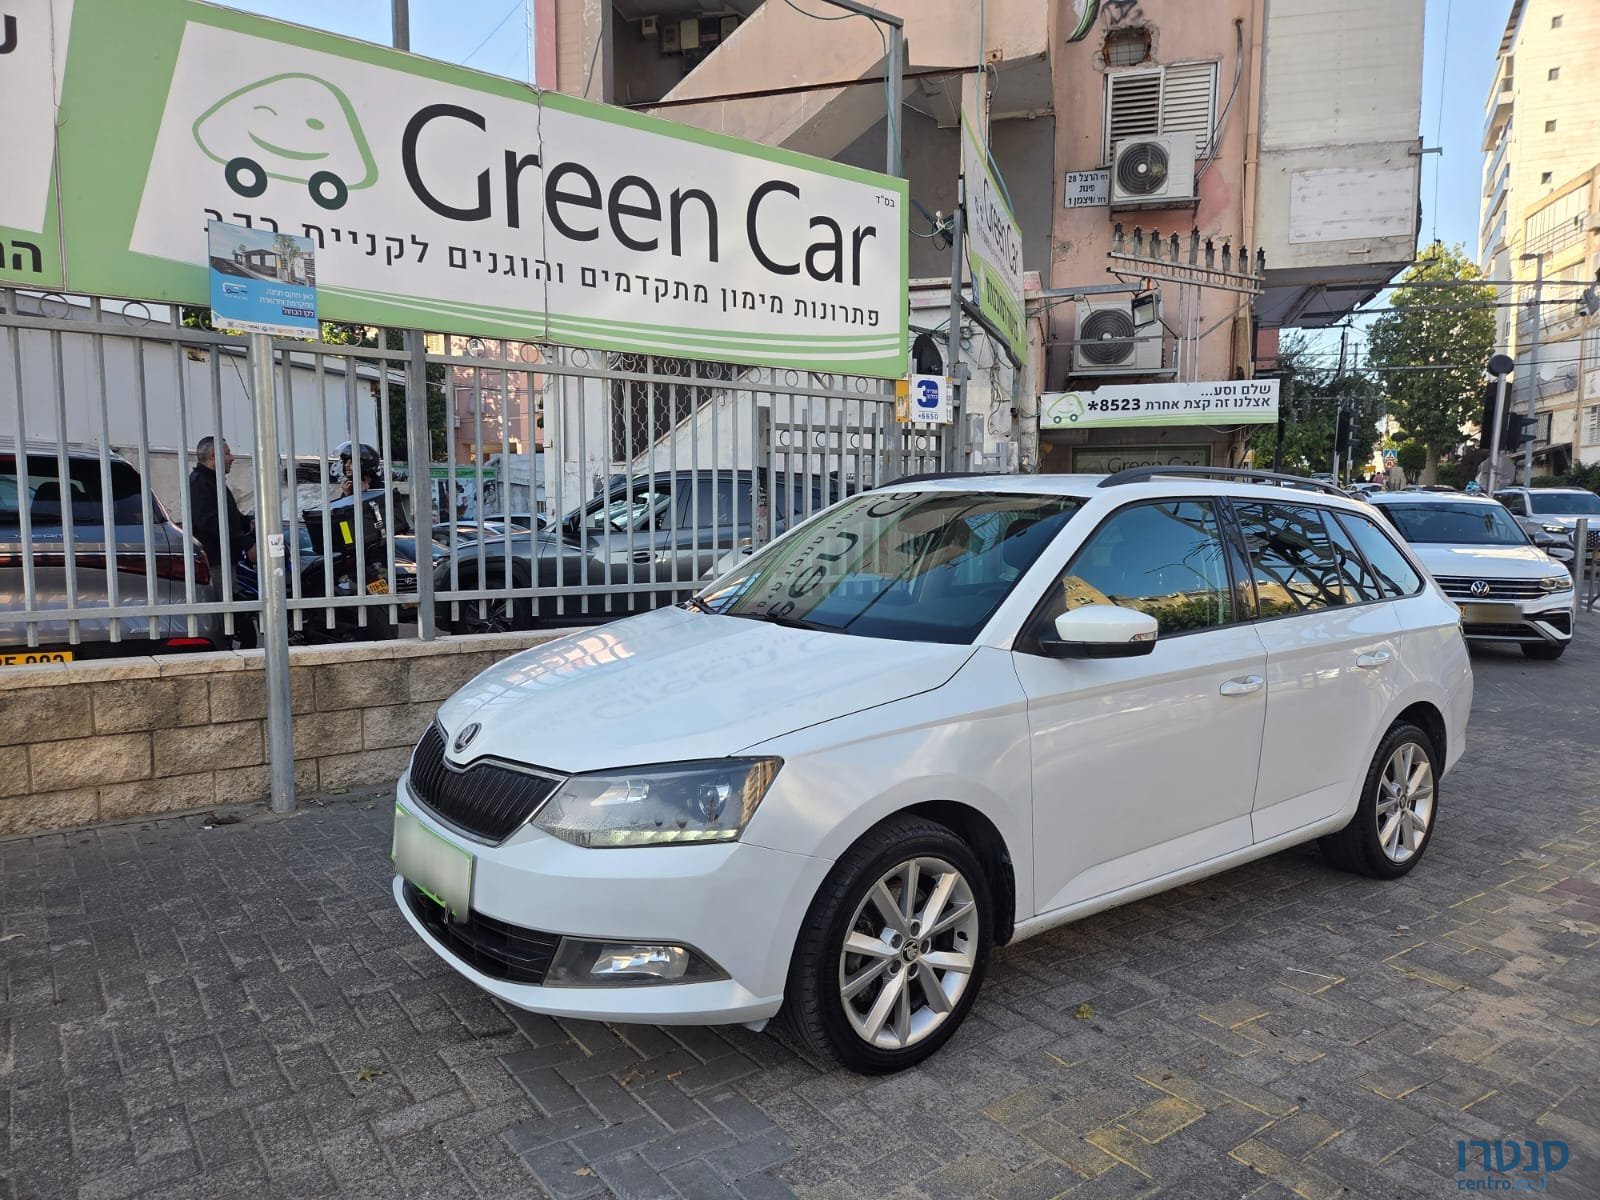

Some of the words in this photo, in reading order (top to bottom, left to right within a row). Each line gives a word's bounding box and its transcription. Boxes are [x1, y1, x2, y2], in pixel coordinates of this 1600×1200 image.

[1068, 175, 1077, 183] 28
[1079, 172, 1099, 182] הרצל
[1079, 184, 1095, 193] פינת
[401, 103, 719, 263] Green
[746, 179, 877, 287] Car
[875, 195, 895, 208] בס"ד
[302, 223, 429, 266] לקניית
[448, 246, 564, 283] והוגנים
[581, 266, 709, 303] מתקדמים
[721, 287, 783, 313] מימון
[794, 298, 879, 327] פתרונות
[1201, 386, 1236, 396] וסע...
[1242, 383, 1271, 395] שלם
[1145, 400, 1180, 410] אחרת
[1183, 399, 1211, 411] קצת
[1215, 398, 1230, 408] זה
[1234, 396, 1270, 407] אצלנו
